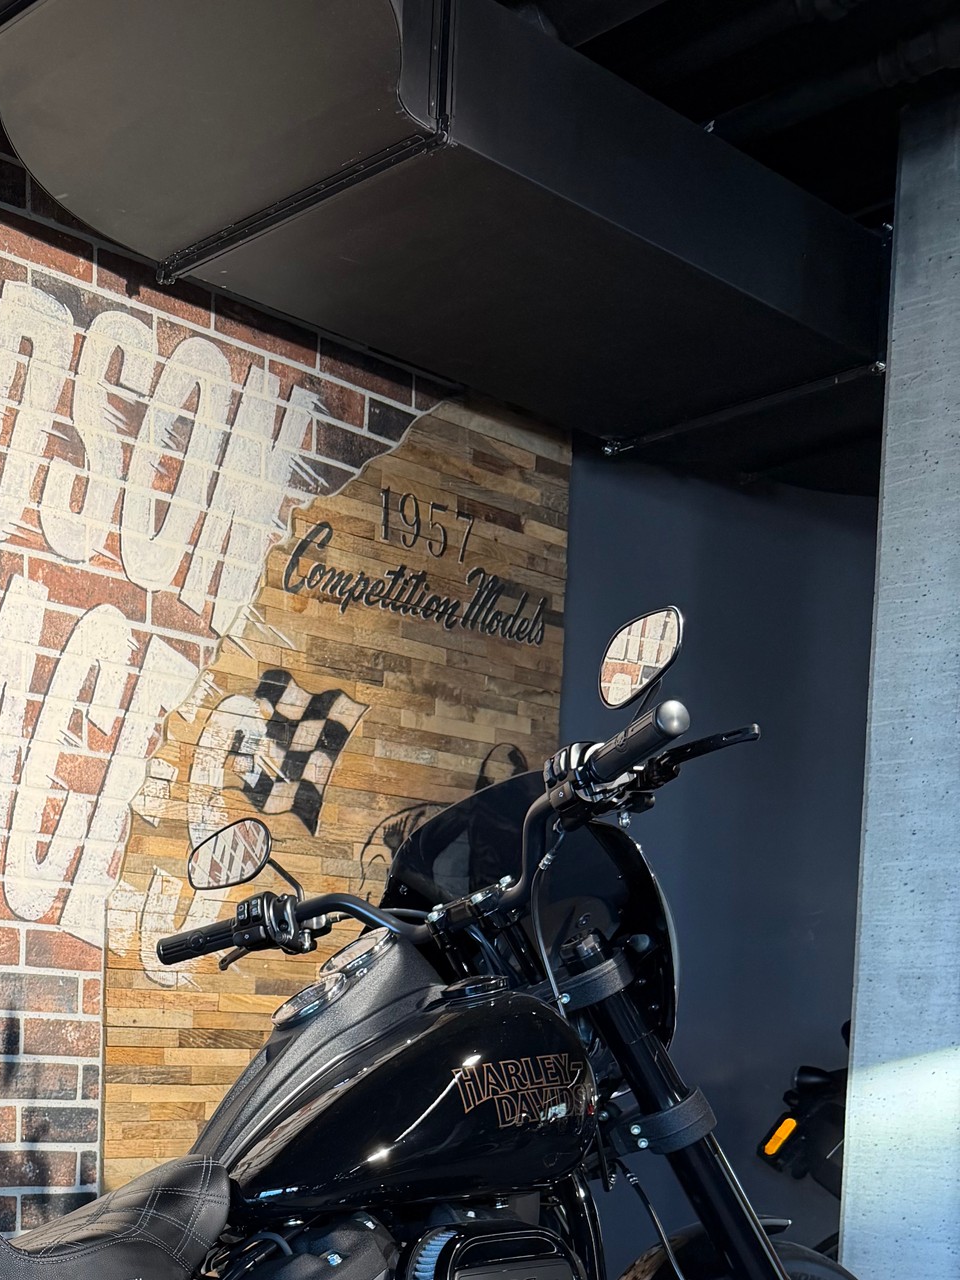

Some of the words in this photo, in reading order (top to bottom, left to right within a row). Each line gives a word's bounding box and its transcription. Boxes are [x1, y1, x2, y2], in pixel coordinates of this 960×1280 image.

[380, 486, 475, 564] 1957
[283, 521, 460, 631] Competition
[461, 567, 547, 647] Models
